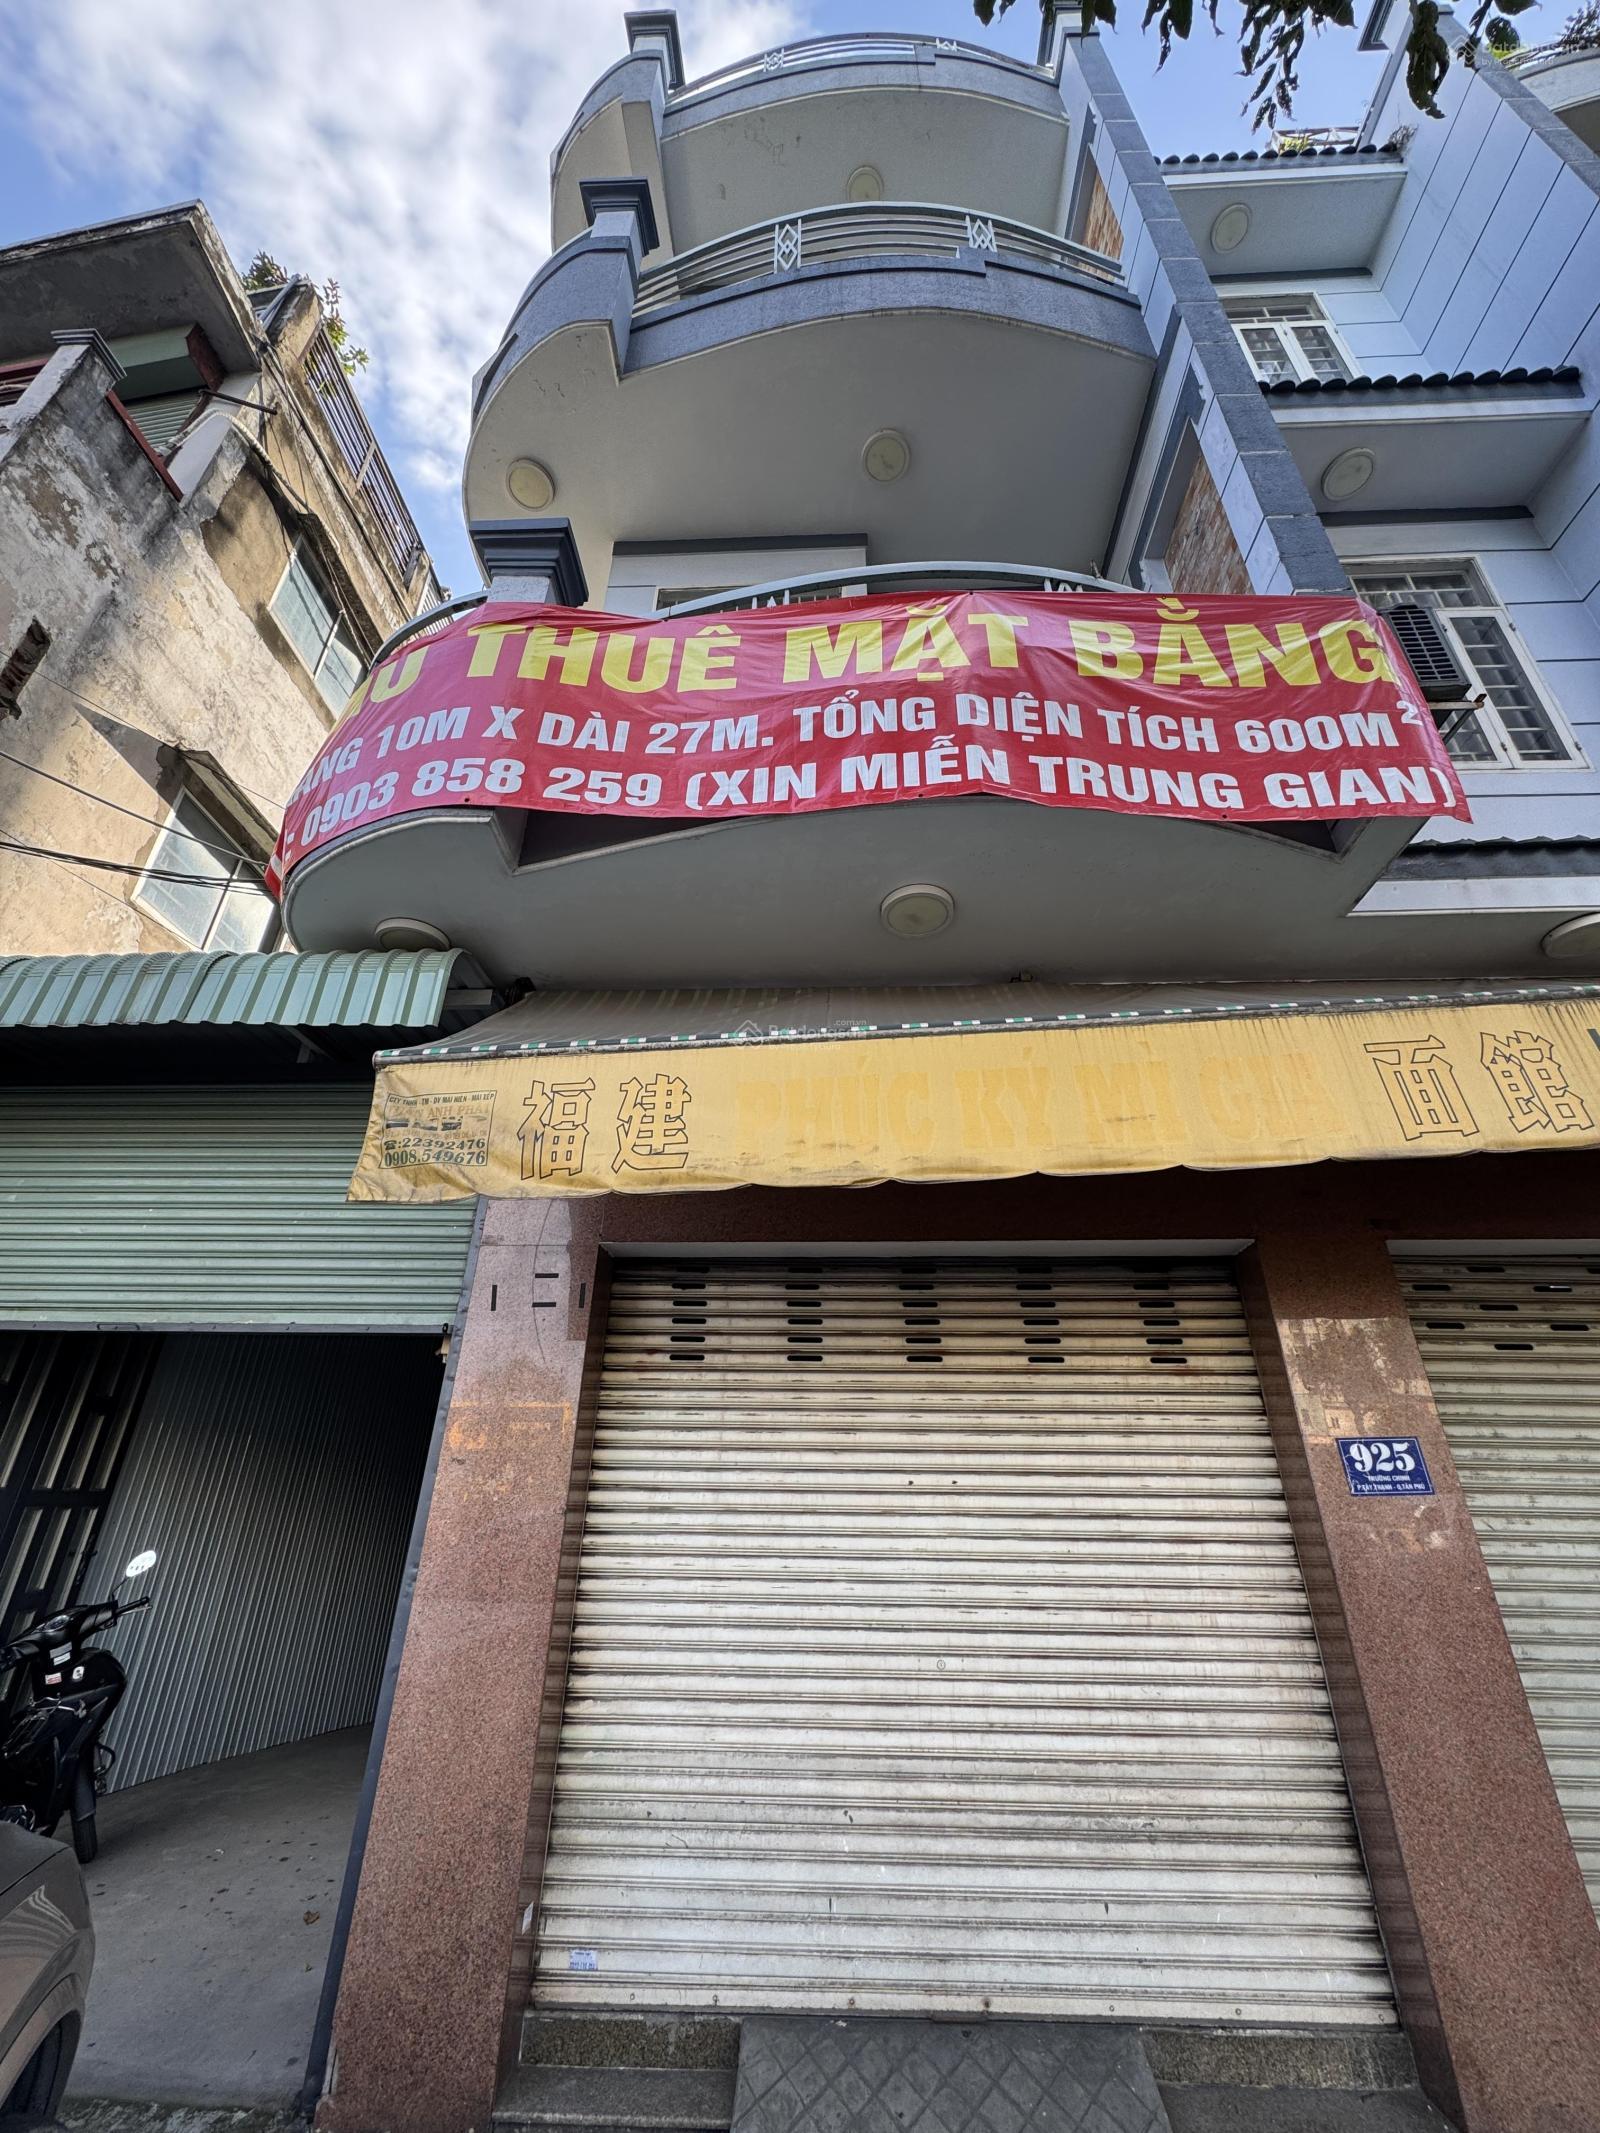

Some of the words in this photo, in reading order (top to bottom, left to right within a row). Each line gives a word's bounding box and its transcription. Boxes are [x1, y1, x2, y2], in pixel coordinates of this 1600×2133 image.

[467, 623, 741, 693] THUÊ
[783, 600, 1029, 683] MẶT
[1069, 597, 1400, 688] BẰNG
[378, 705, 470, 759] 10M
[483, 705, 525, 740] X
[537, 711, 630, 754] DÀI
[646, 714, 773, 754] 27M.
[793, 690, 936, 742] TỔNG
[956, 691, 1081, 743] DIỆN
[1096, 705, 1219, 754] TÍCH
[301, 771, 398, 847] 0903
[411, 757, 526, 797] 858
[542, 766, 662, 806] 259
[685, 762, 817, 811] (XIN
[841, 734, 1011, 793] MIỄN
[1029, 755, 1244, 809] TRUNG
[1262, 766, 1457, 809] GIAN)
[384, 1148, 485, 1167] 0908.549676
[1350, 1442, 1415, 1472] 925
